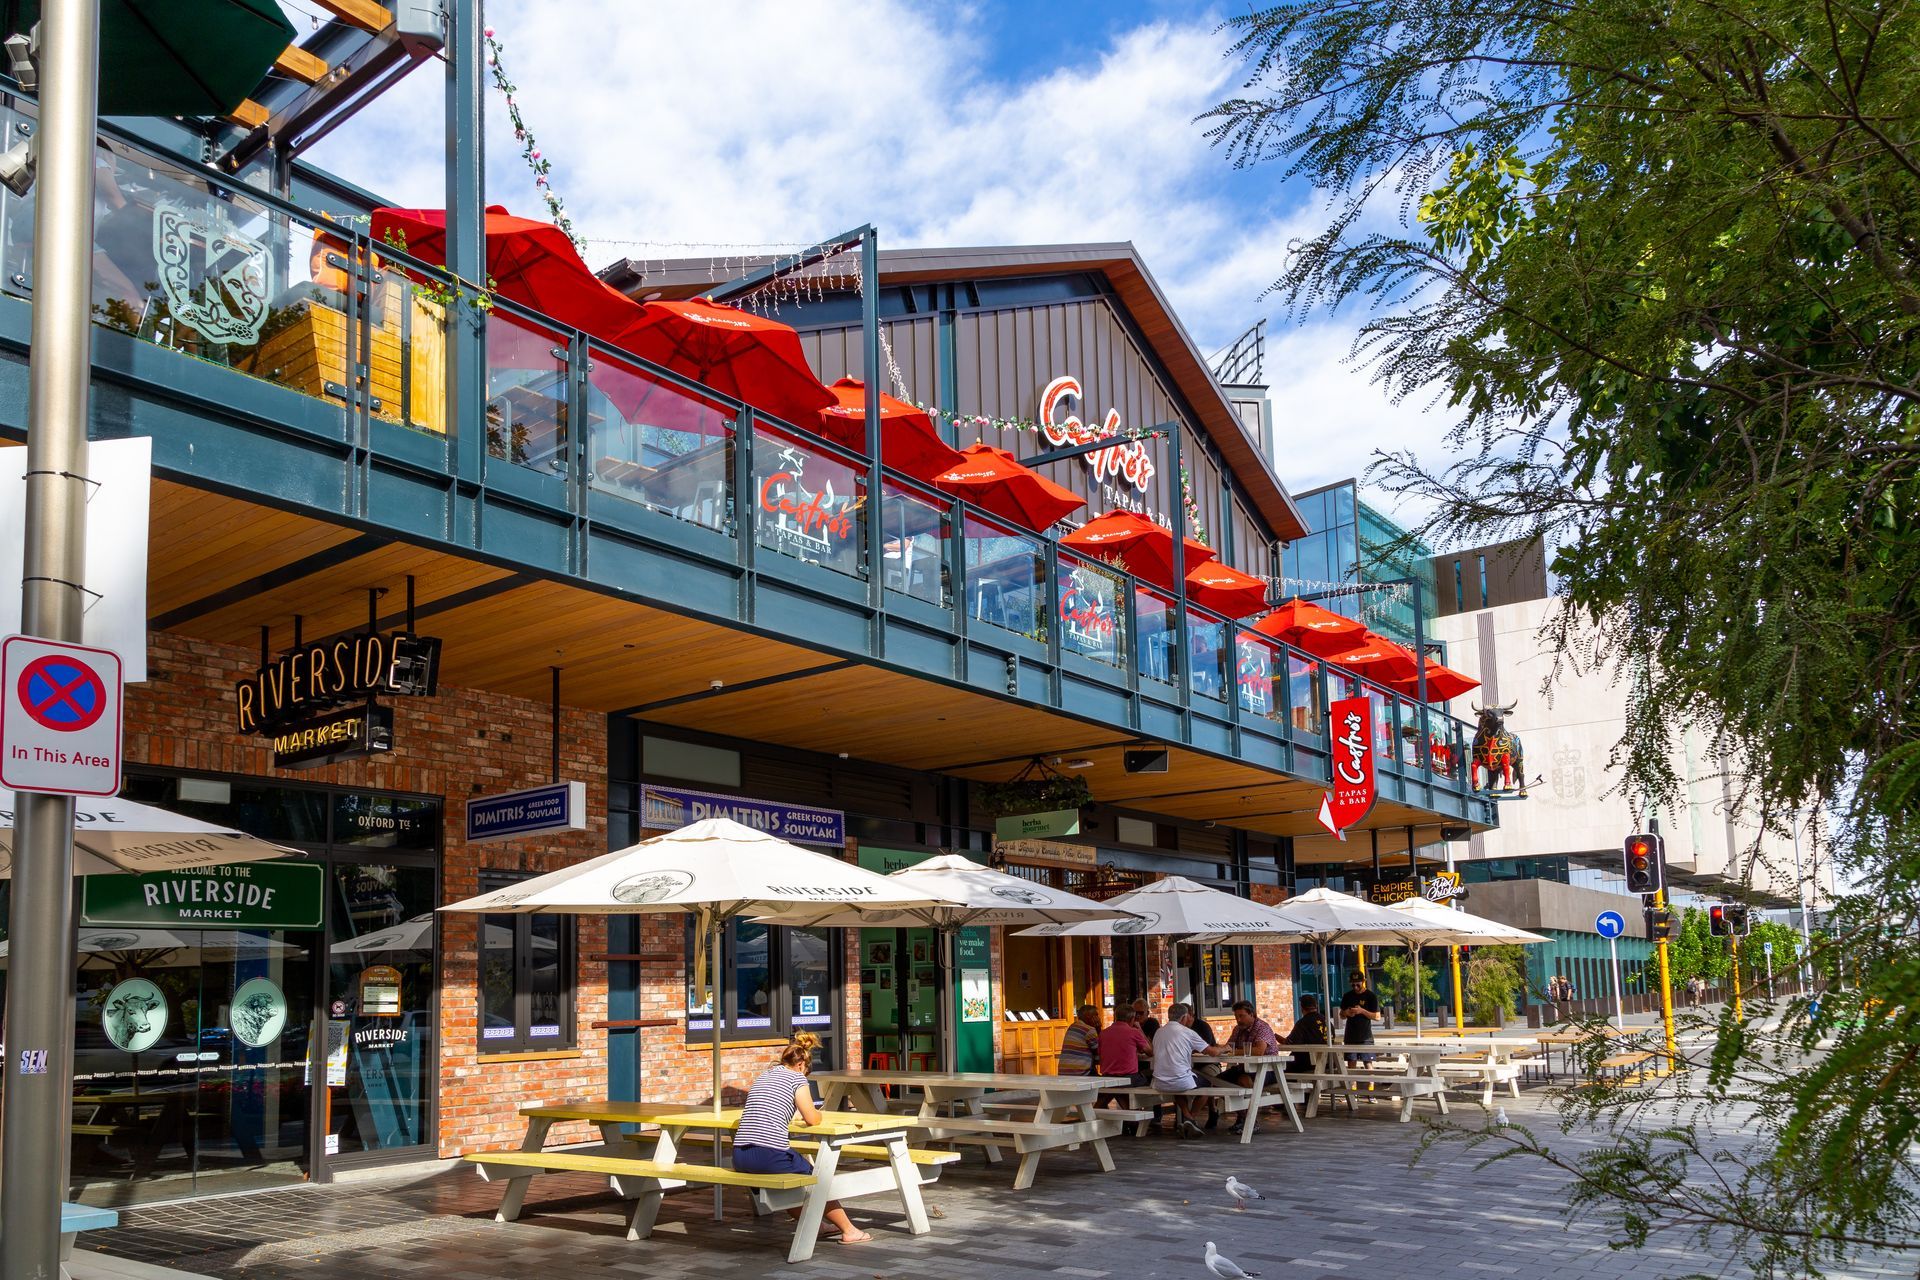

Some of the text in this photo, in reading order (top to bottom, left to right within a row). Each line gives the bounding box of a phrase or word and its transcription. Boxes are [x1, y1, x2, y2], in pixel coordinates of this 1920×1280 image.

[1104, 484, 1142, 514] TAPAS
[1159, 512, 1173, 531] BA
[775, 527, 804, 545] TAPAS
[815, 542, 832, 554] BAR
[239, 637, 406, 730] RIVERSIDE
[274, 718, 359, 754] MARKET
[1337, 711, 1369, 785] Castro's
[12, 745, 110, 768] In This Area
[1339, 788, 1367, 797] TAPAS
[528, 798, 560, 809] GREEK FOOD
[1348, 797, 1366, 805] BAR
[475, 806, 524, 826] DIMITRIS
[526, 806, 561, 820] SOUVLAKI
[691, 801, 780, 831] DIMITRIS
[786, 811, 834, 825] GREEK FOOD
[358, 815, 395, 829] OXFORD
[1022, 818, 1042, 827] herba
[784, 823, 836, 840] SOUVLAKI
[219, 866, 232, 877] TO
[234, 866, 251, 878] THE
[766, 885, 879, 896] RIVERSIDE
[1373, 881, 1414, 894] EMPIRE
[143, 880, 276, 910] RIVERSIDE
[1371, 891, 1418, 903] CHICKEN
[179, 908, 242, 919] MARKET
[1203, 921, 1274, 929] RIVERSIDE
[969, 938, 985, 947] make
[355, 1029, 408, 1043] RIVERSIDE
